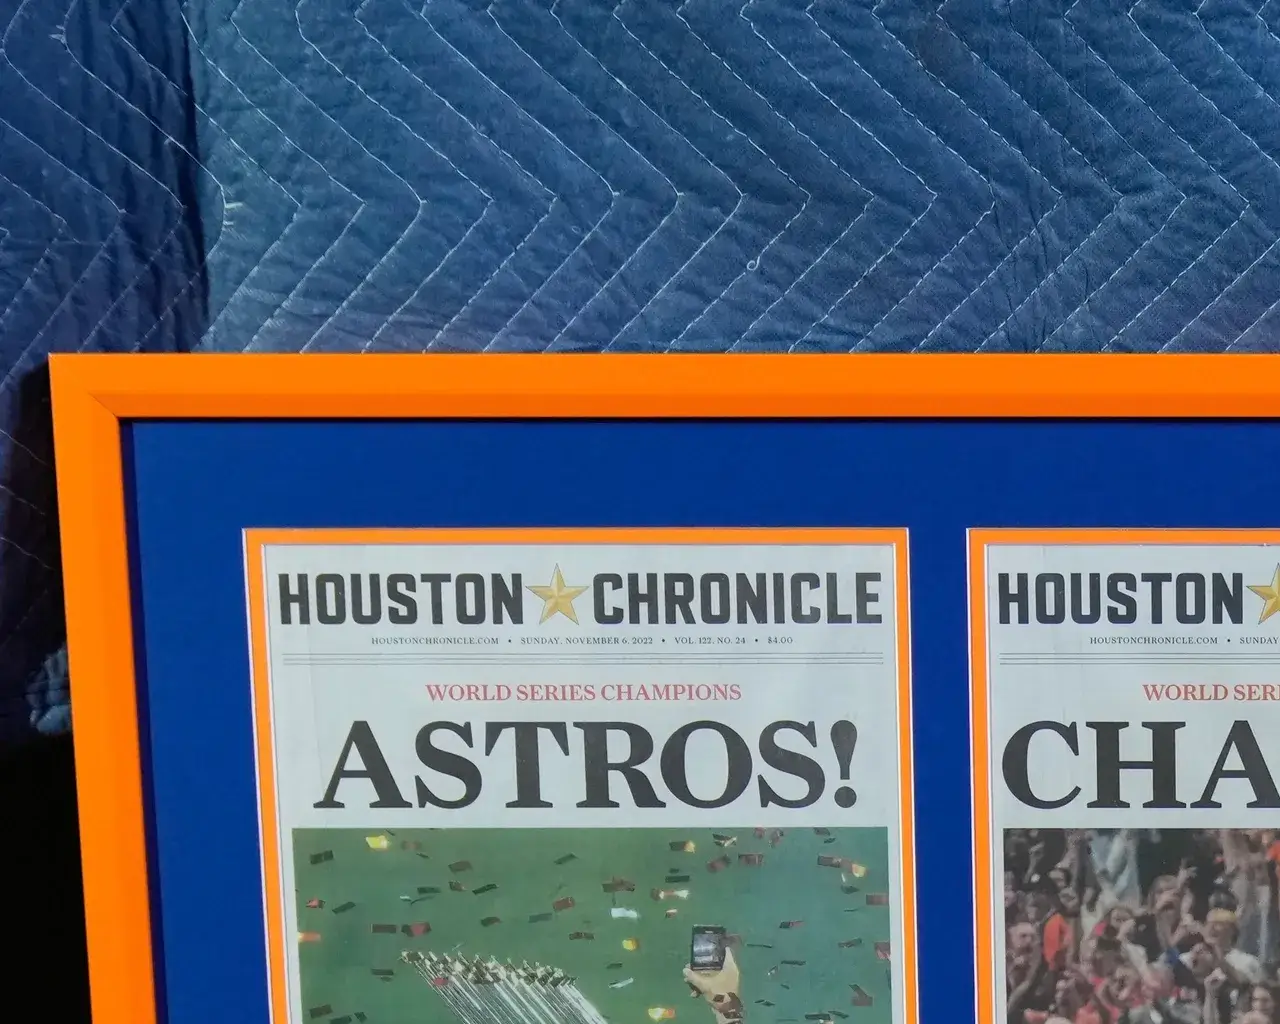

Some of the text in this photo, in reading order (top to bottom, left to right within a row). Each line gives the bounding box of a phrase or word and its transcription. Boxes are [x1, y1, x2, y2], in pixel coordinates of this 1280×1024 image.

[279, 572, 882, 624] HOUSTON CHRONICLE
[998, 573, 1243, 624] HOUSTON
[372, 635, 793, 645] HOUSTONCHRONICLE.COM SUNDAY, NOVEMBER 6, 2022 VOL. 122, NO. 24 $4.00
[1090, 636, 1217, 645] HOUSTONCHRONICLE.COM
[1240, 636, 1280, 645] SUNDAY,
[425, 684, 741, 701] WORLD SERIES CHAMPIONS
[1142, 684, 1228, 700] WORLD
[313, 720, 857, 809] ASTROS!
